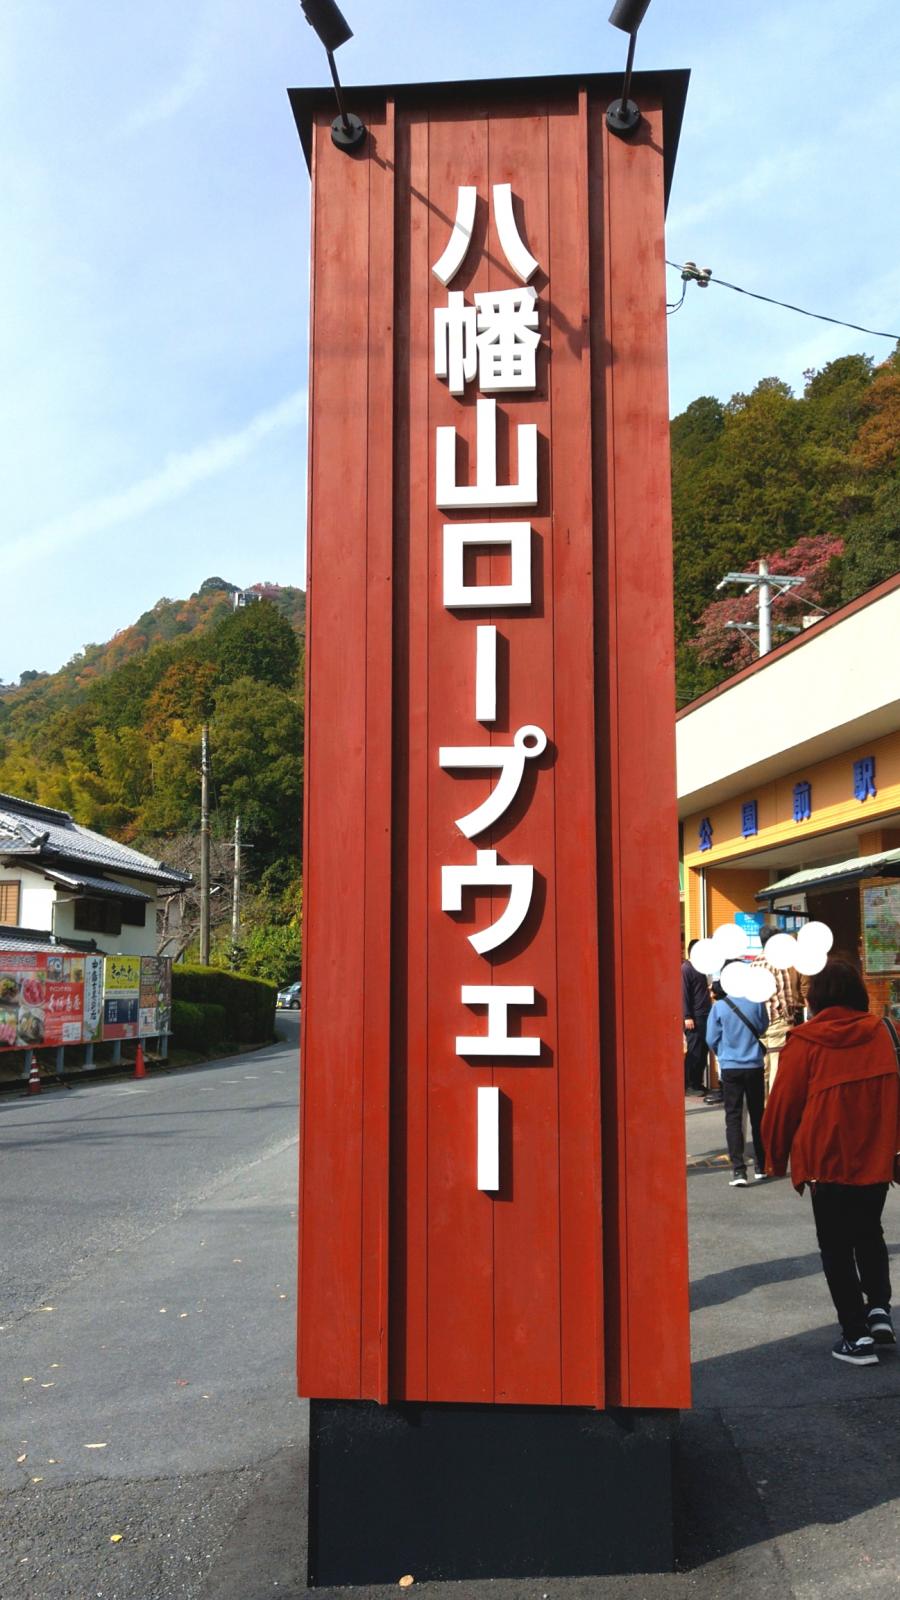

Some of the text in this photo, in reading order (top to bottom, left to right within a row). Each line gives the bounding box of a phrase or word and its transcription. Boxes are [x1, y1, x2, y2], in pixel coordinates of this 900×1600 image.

[432, 182, 550, 1192] 八幡山ロープウェー
[698, 756, 877, 851] 公園前駅
